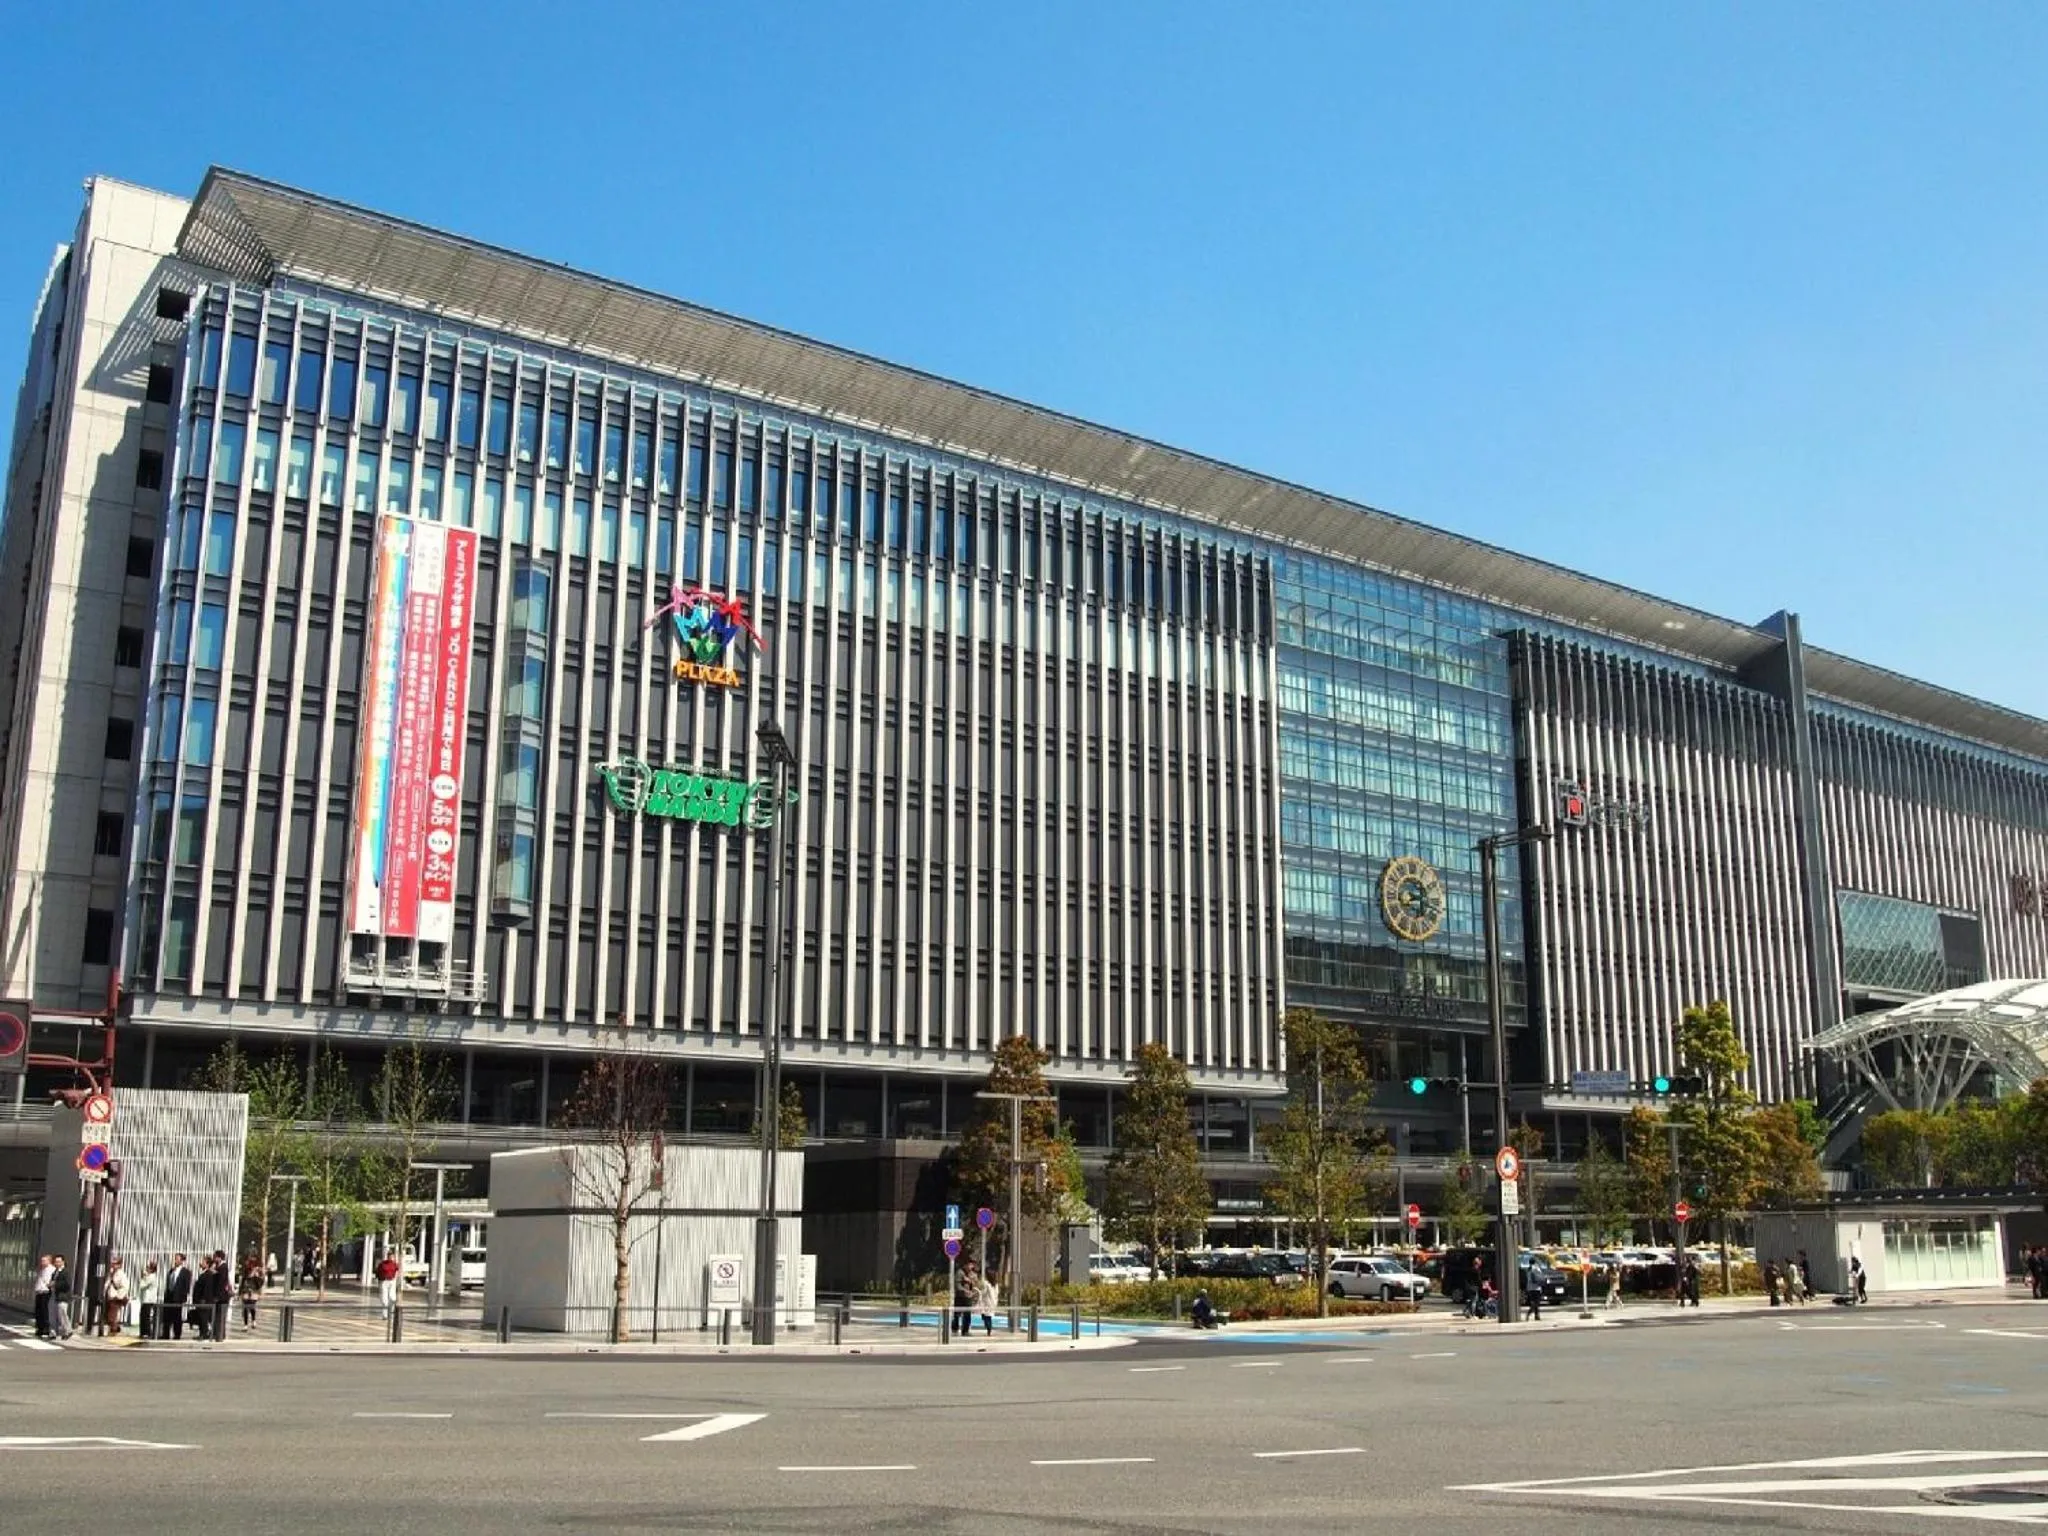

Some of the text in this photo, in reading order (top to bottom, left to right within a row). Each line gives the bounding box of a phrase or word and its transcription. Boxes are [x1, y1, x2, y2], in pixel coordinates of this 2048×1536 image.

[677, 660, 740, 687] PLAZA
[653, 770, 747, 804] TOKYU
[647, 791, 740, 827] HANDS
